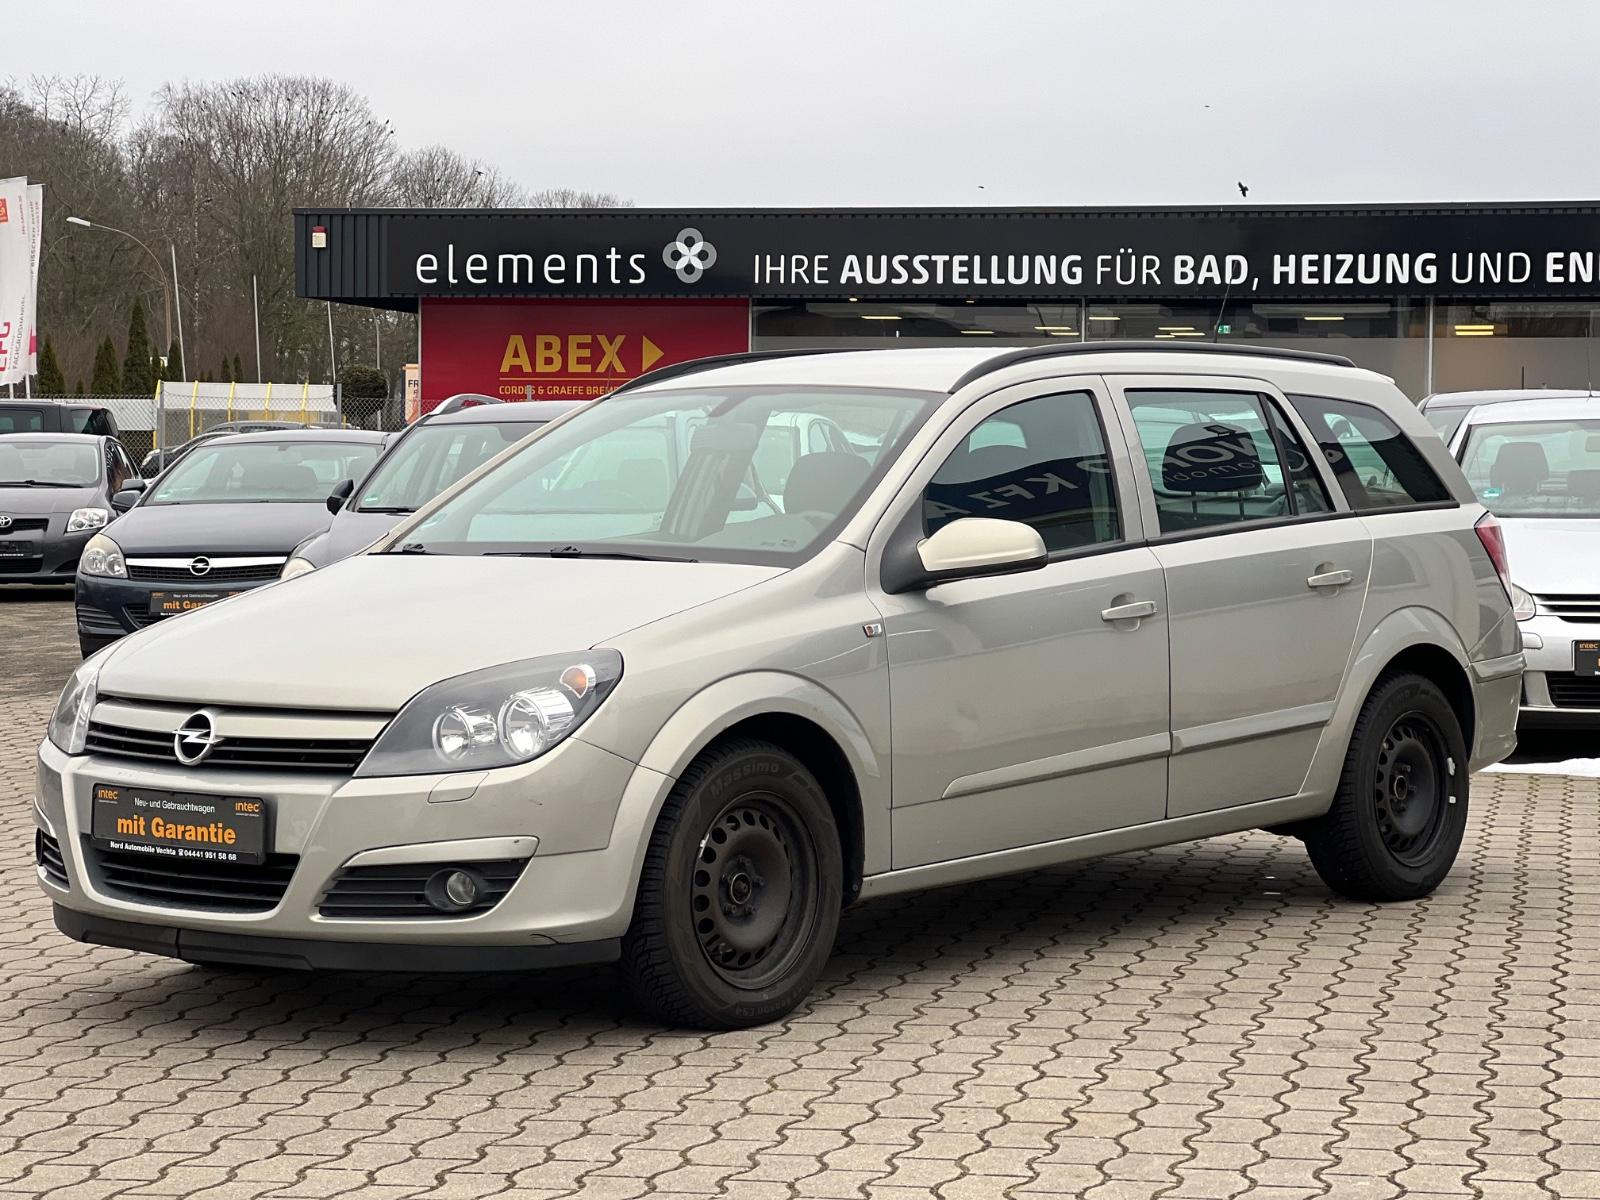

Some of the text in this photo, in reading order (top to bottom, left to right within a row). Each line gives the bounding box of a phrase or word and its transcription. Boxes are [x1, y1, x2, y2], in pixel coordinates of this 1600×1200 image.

[416, 244, 646, 284] elements
[753, 254, 829, 284] IHRE
[839, 254, 1083, 285] AUSSTELLUNG
[1096, 248, 1161, 285] FÜR
[1173, 254, 1259, 291] BAD,
[1273, 253, 1437, 285] HEIZUNG
[1451, 252, 1531, 284] UND
[500, 335, 626, 373] ABEX
[537, 385, 545, 395] &
[546, 385, 584, 395] GRAEFE
[98, 789, 119, 800] intec
[134, 796, 215, 814] Neu- und Gebrauchtwagen
[235, 801, 260, 813] intec
[117, 814, 237, 845] mit Garantie
[110, 840, 237, 861] Nord Automobile Vechta 04441 951 58 68
